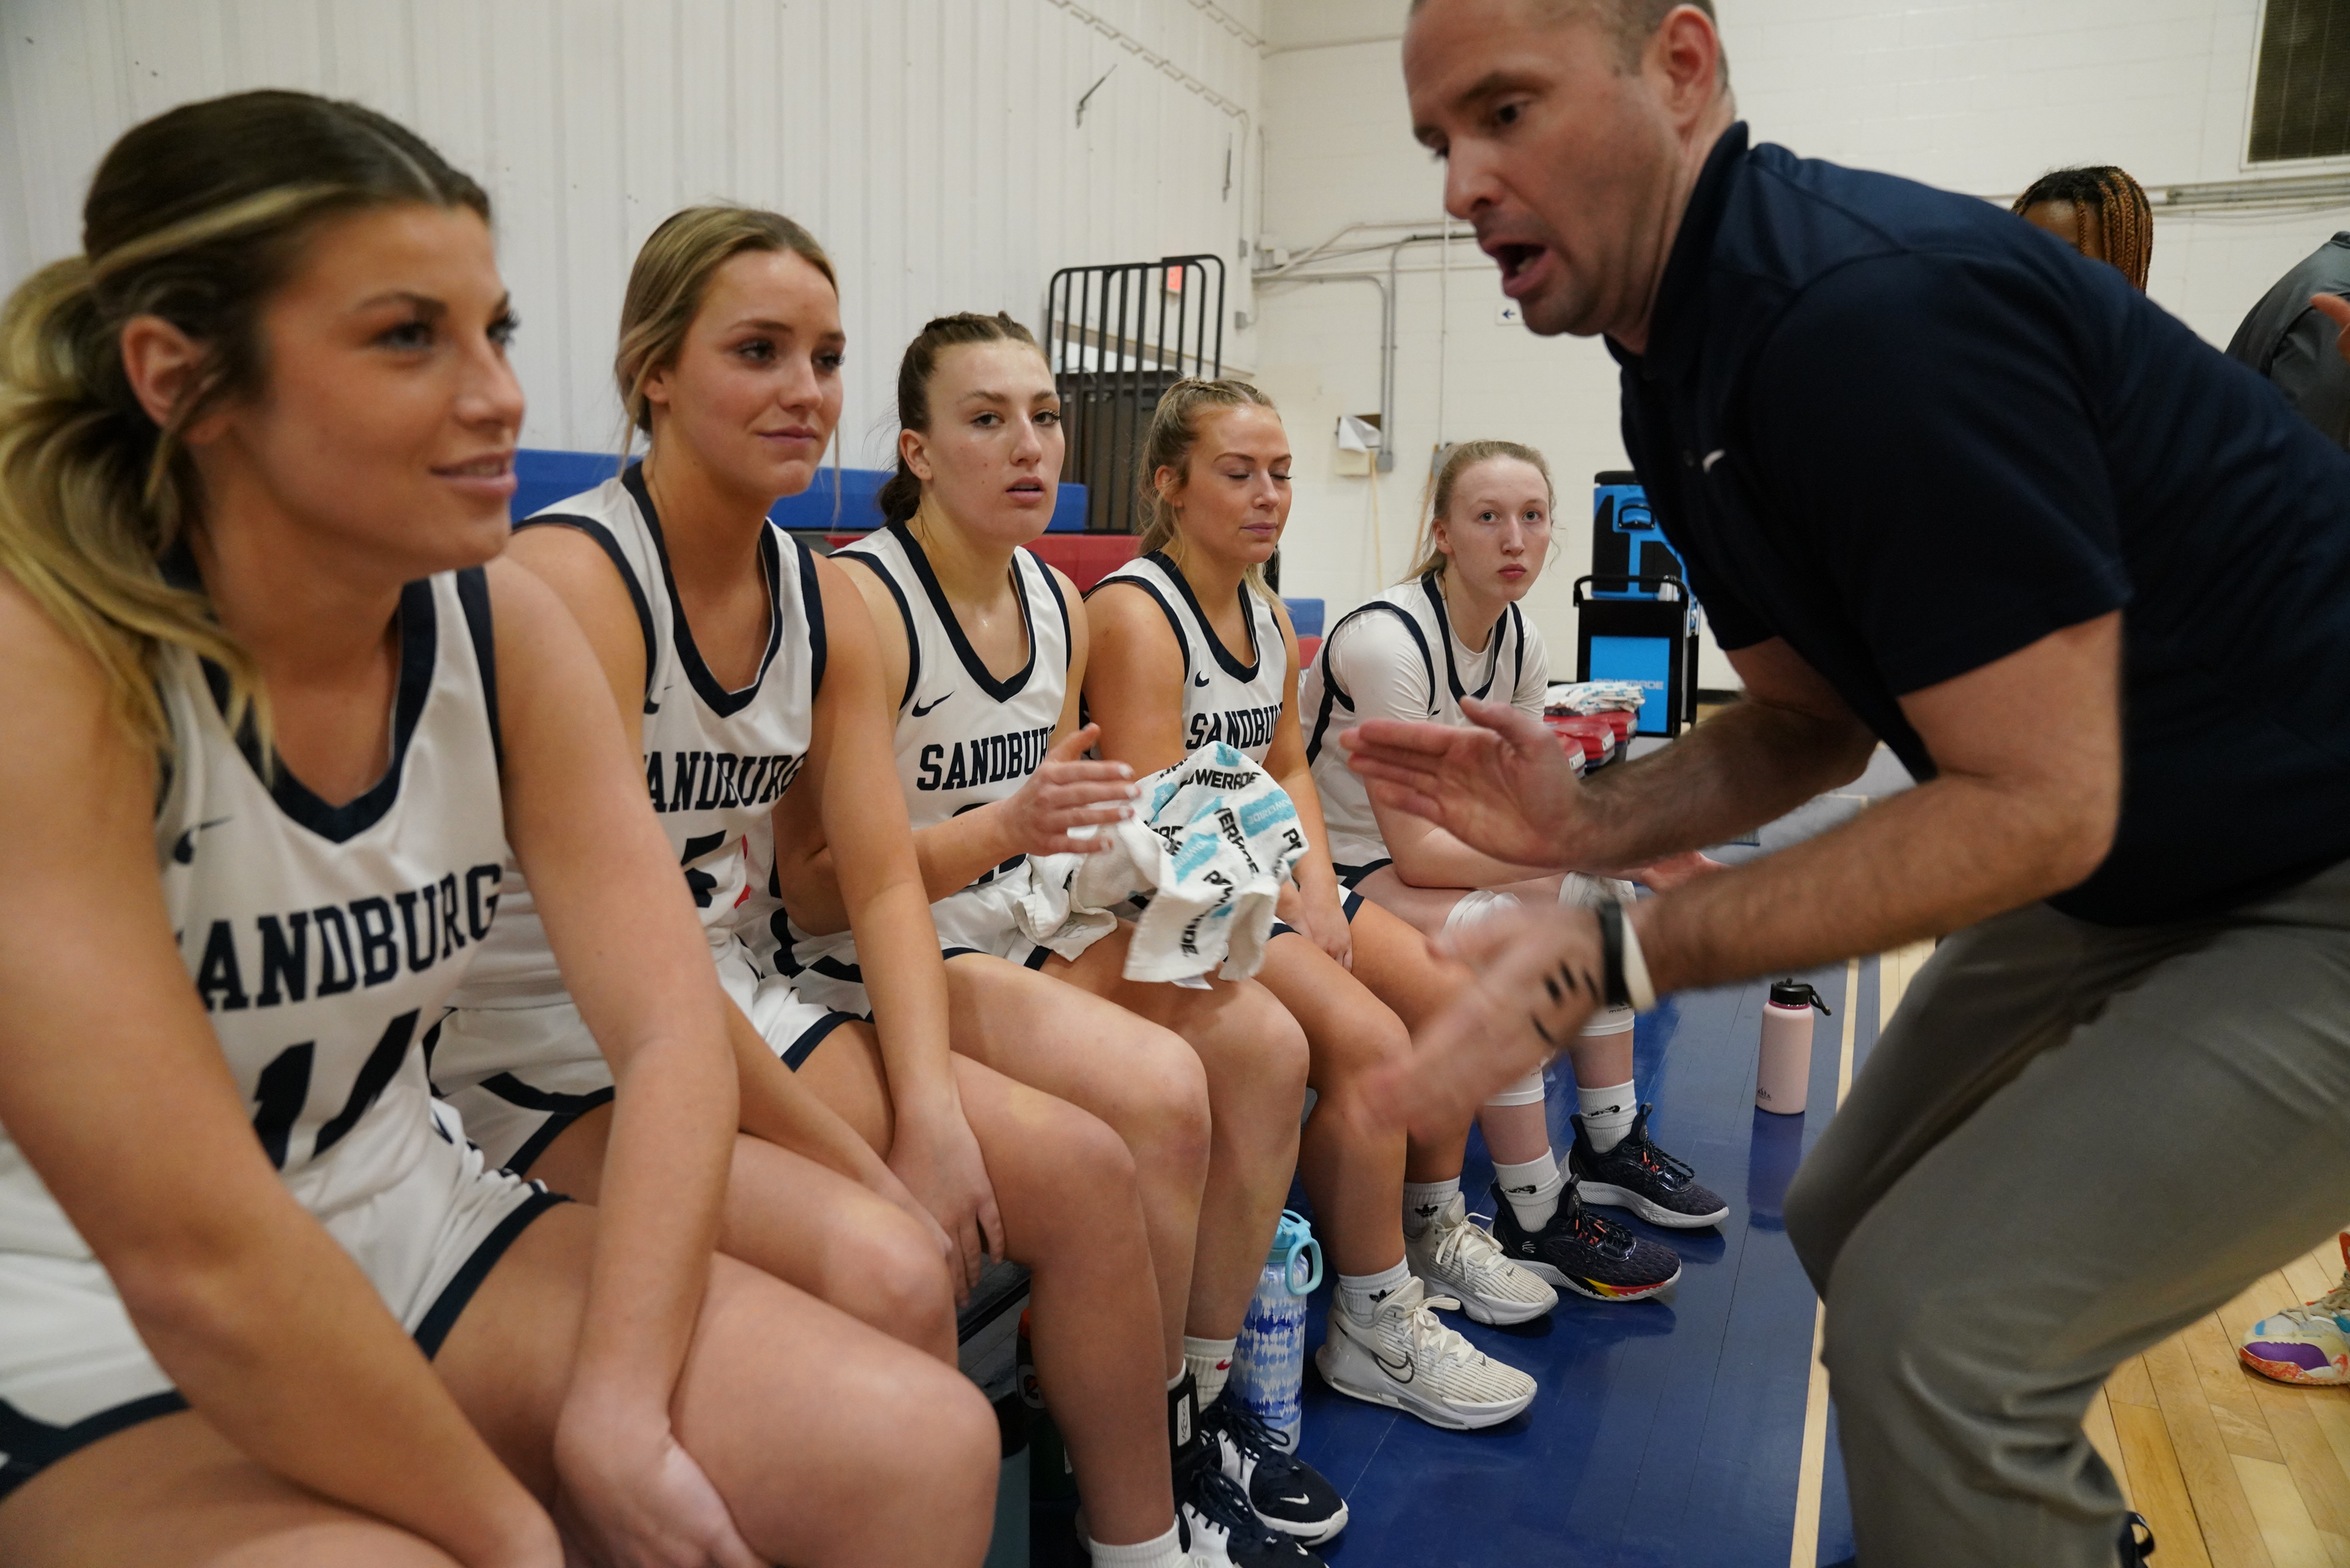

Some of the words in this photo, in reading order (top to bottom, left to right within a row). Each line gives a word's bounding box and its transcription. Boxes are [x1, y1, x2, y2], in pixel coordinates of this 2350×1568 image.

[643, 751, 809, 813] ANDBURG
[916, 723, 1056, 791] SANDBUR
[175, 863, 503, 1013] ANDBURG
